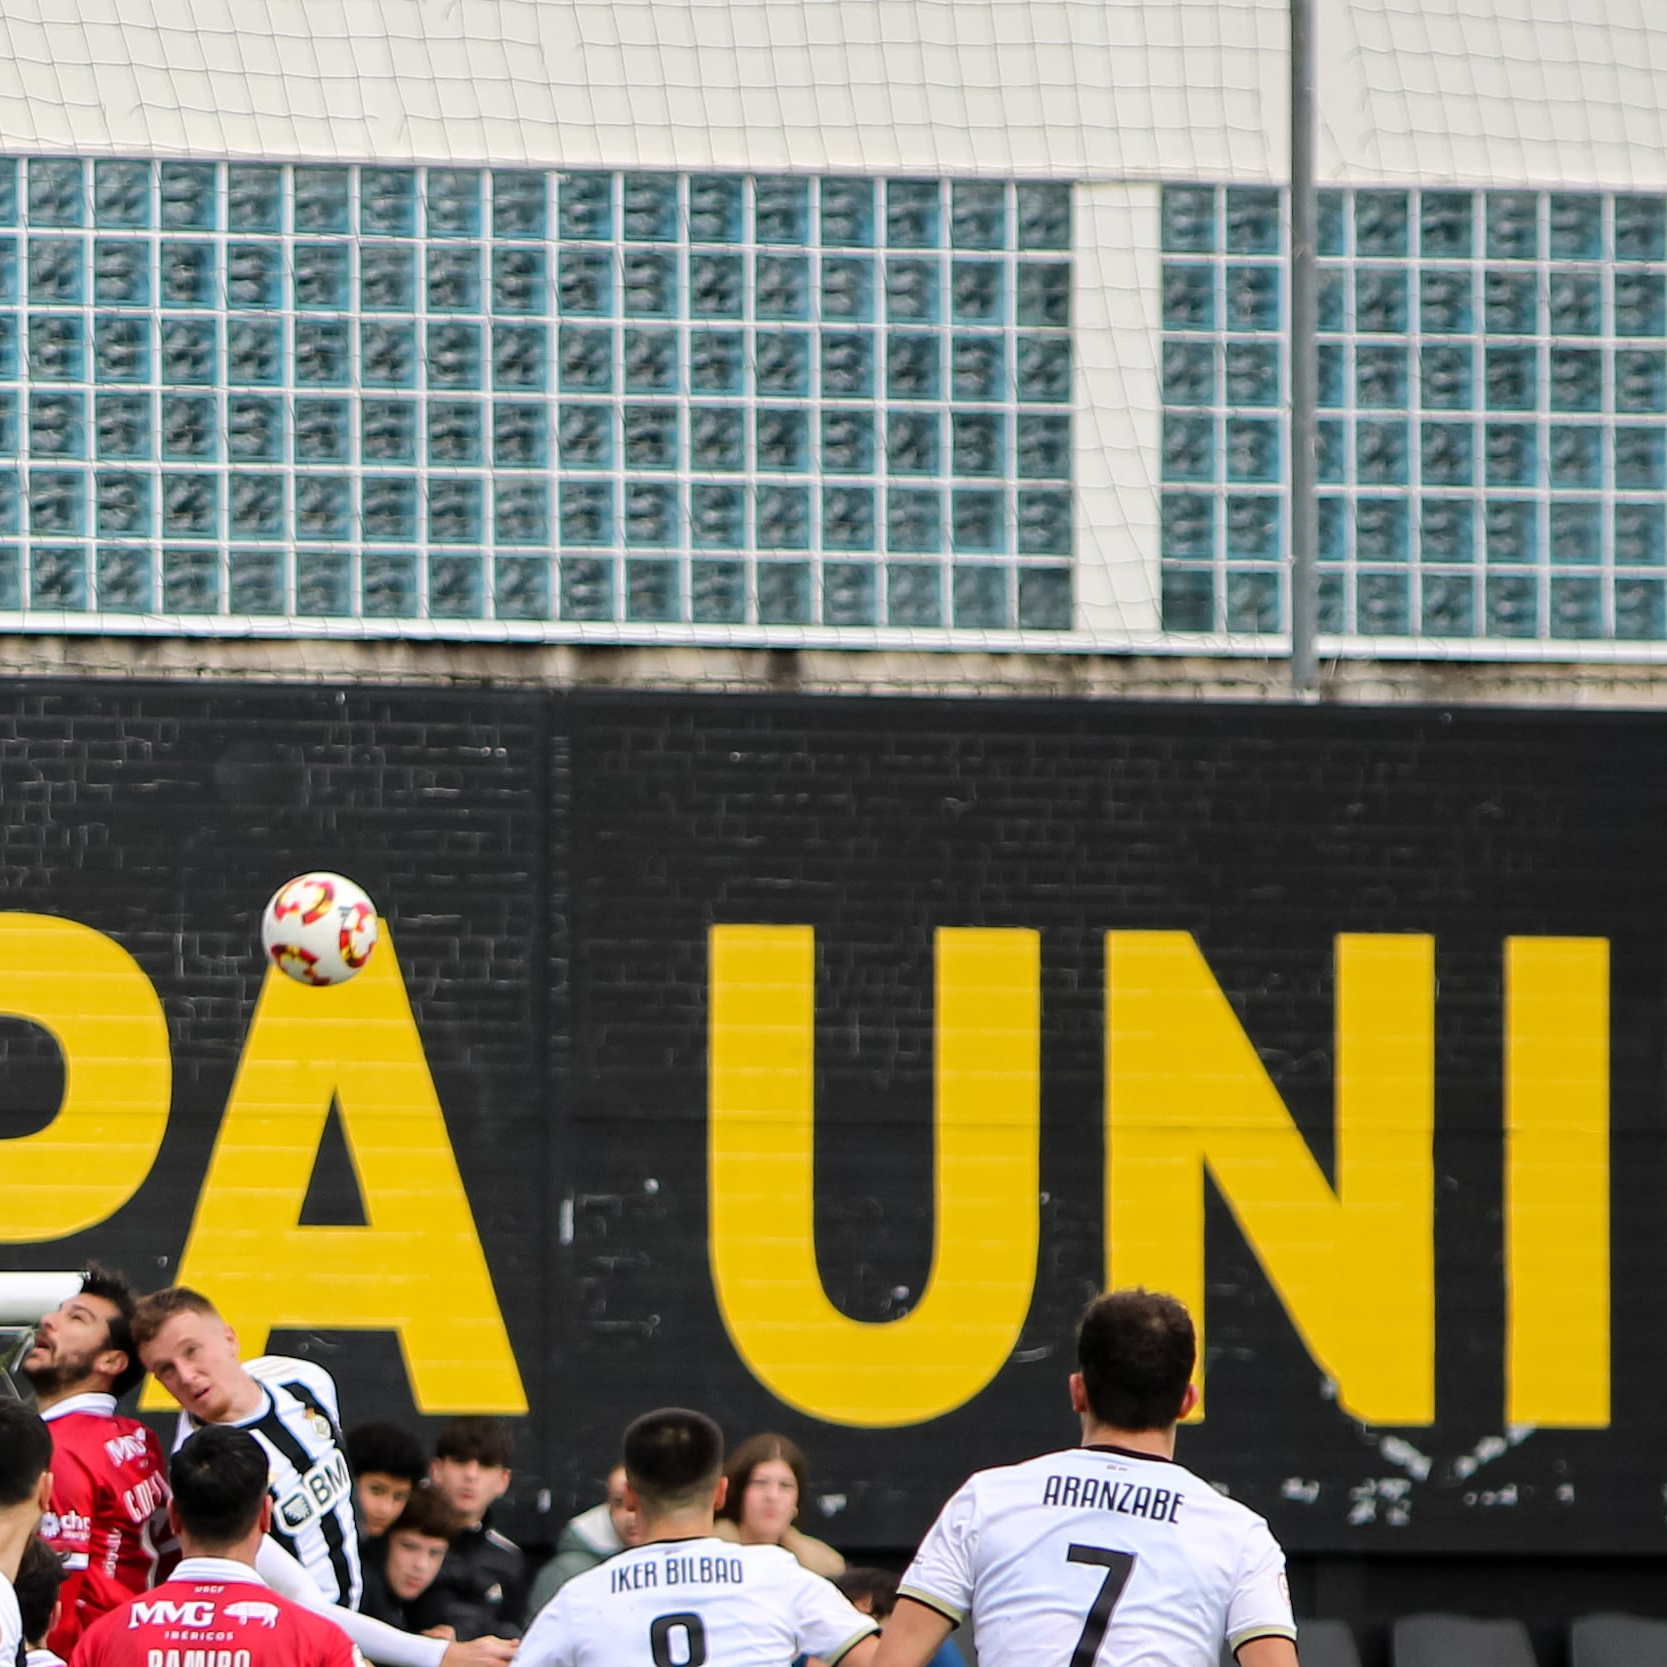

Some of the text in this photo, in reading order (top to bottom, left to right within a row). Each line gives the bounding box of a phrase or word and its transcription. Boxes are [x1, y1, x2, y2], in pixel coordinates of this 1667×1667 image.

[707, 923, 1612, 1429] UNI
[1042, 1475, 1186, 1525] ARANZABE
[610, 1556, 744, 1594] IKER BILBAO
[127, 1600, 216, 1630] MMG
